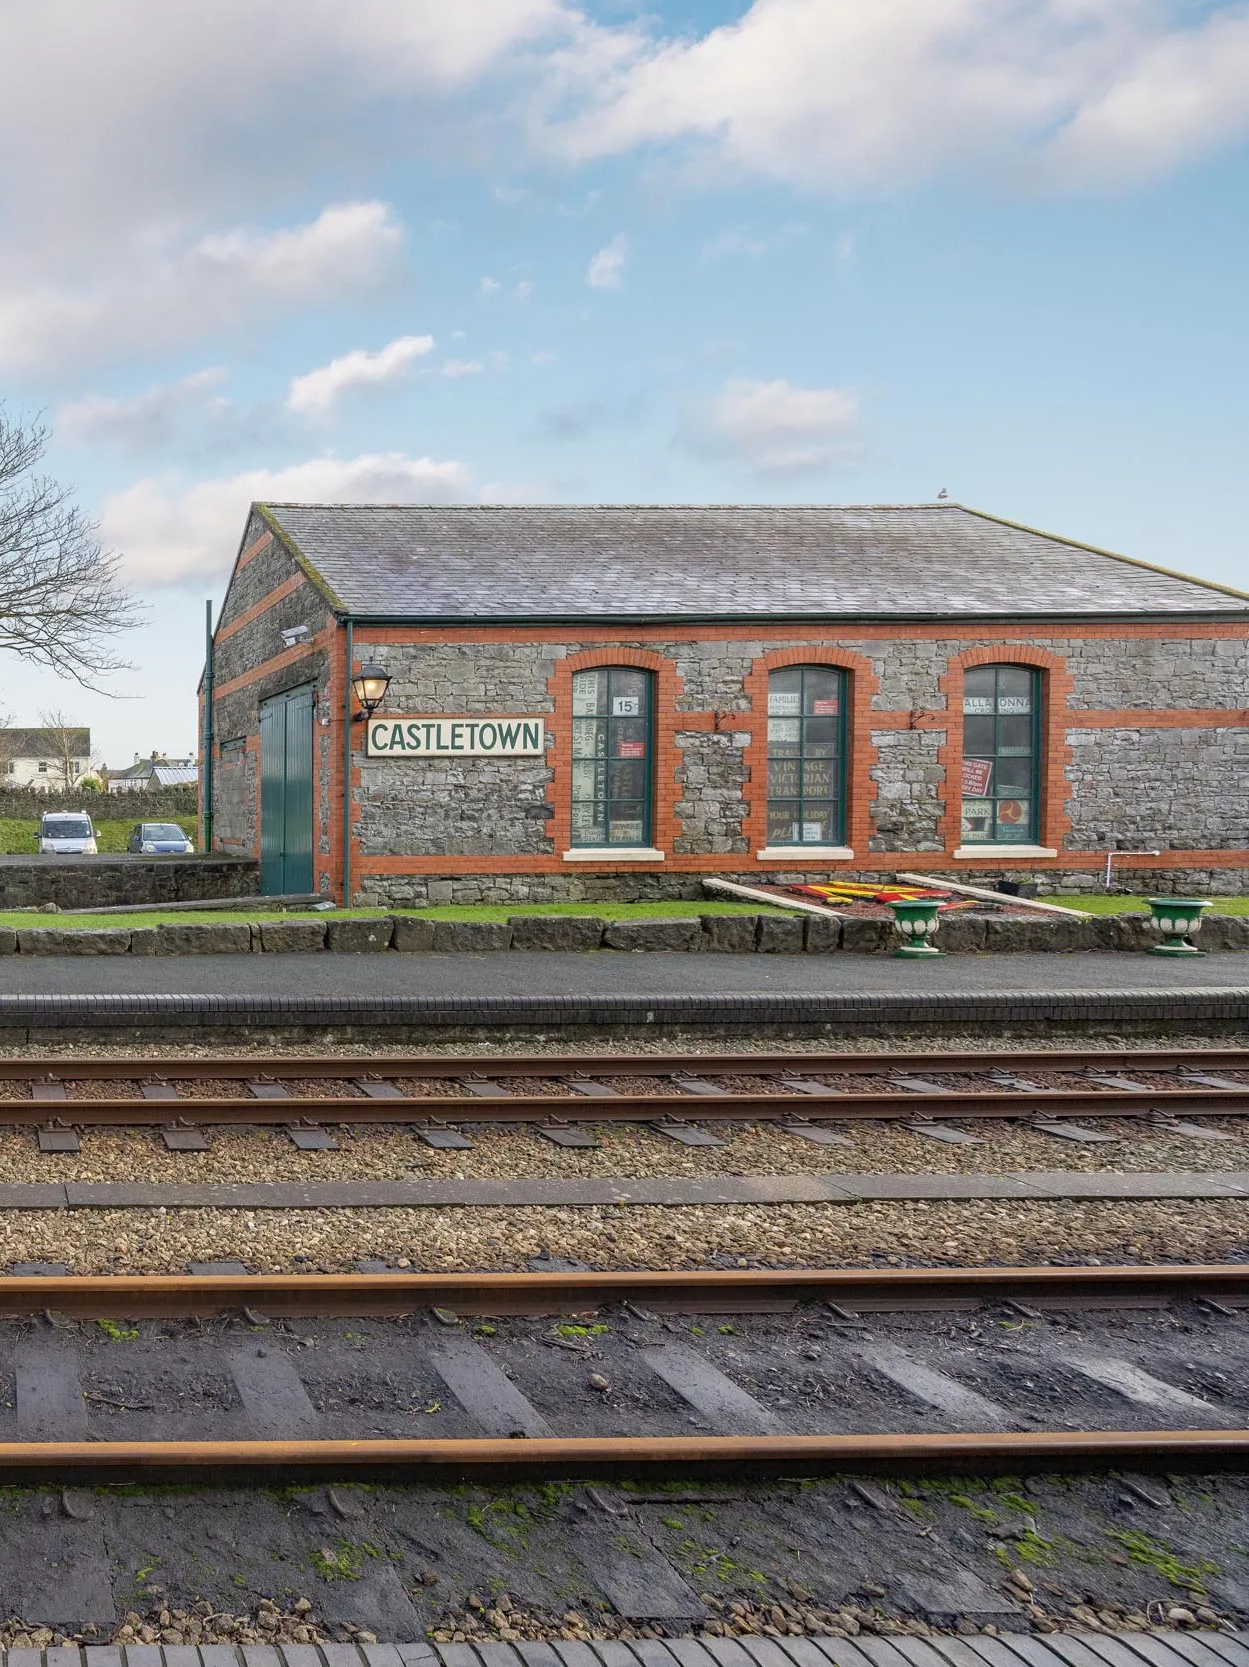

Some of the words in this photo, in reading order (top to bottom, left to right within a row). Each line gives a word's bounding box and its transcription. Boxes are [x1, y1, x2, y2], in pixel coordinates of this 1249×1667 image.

[618, 701, 632, 712] 15
[964, 698, 1031, 707] ALLAONNA
[371, 722, 539, 750] CASTLETOWN
[772, 748, 807, 757] TRAVL
[773, 761, 826, 771] VINAGE
[597, 733, 605, 821] CASTLETOWN
[962, 773, 982, 781] OCKED
[770, 786, 829, 796] TRANPORT
